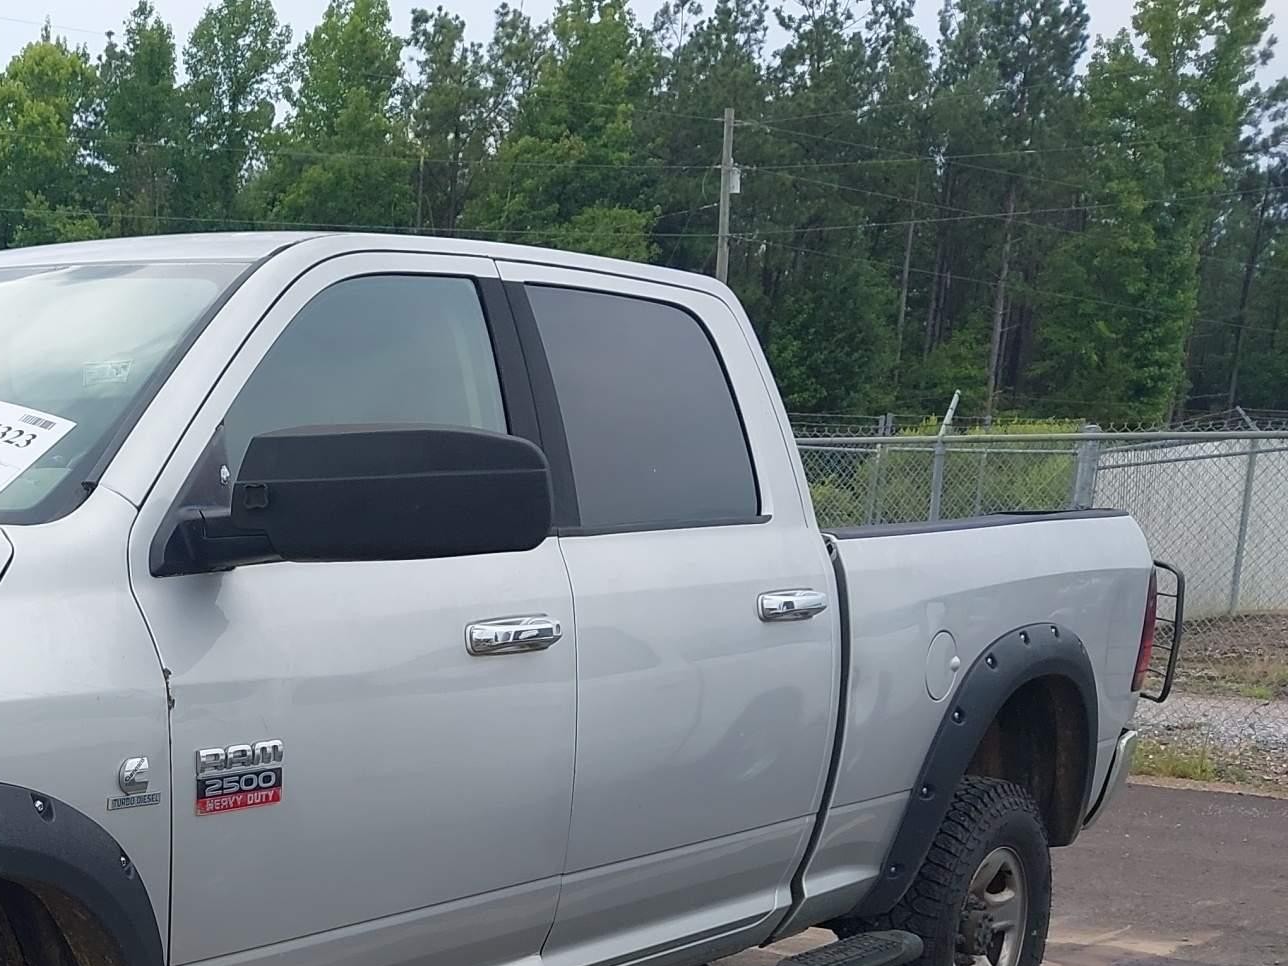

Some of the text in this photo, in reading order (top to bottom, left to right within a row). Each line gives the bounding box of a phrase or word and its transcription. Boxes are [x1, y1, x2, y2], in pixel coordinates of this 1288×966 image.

[196, 739, 283, 775] RAM
[205, 771, 276, 797] 2500
[136, 793, 160, 805] DIESEL
[206, 790, 274, 811] HEAVY DUTY
